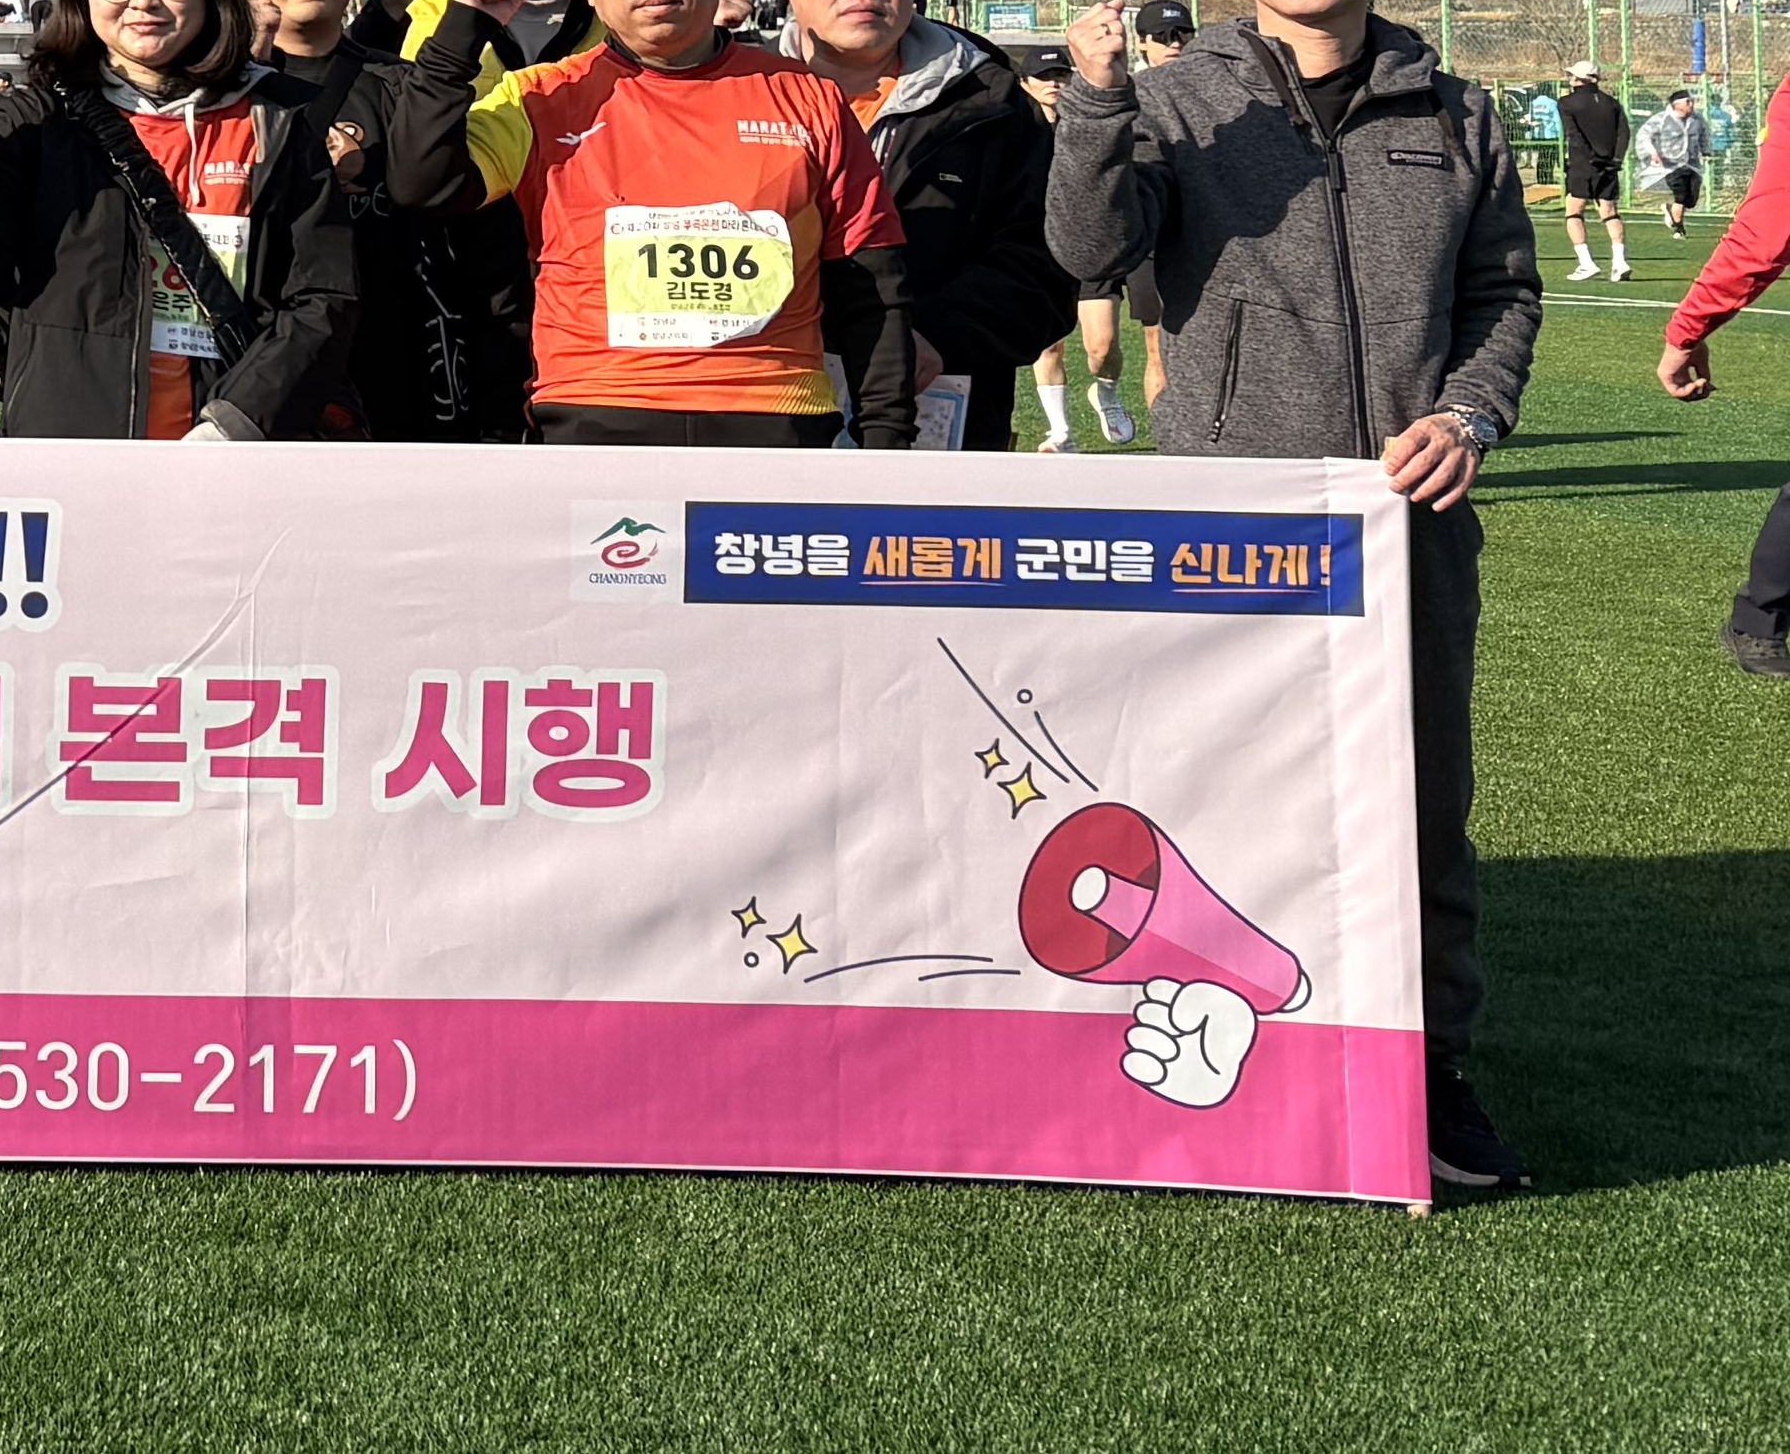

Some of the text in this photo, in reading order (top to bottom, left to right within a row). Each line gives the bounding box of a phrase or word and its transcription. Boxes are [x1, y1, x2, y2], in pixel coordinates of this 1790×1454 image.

[638, 243, 759, 281] 1306
[666, 281, 733, 302] 김도경
[713, 532, 851, 578] 창녕을
[862, 536, 1004, 580] 새롭게
[1015, 538, 1156, 583] 군민을
[58, 676, 328, 806] 본격
[383, 678, 654, 809] 시행
